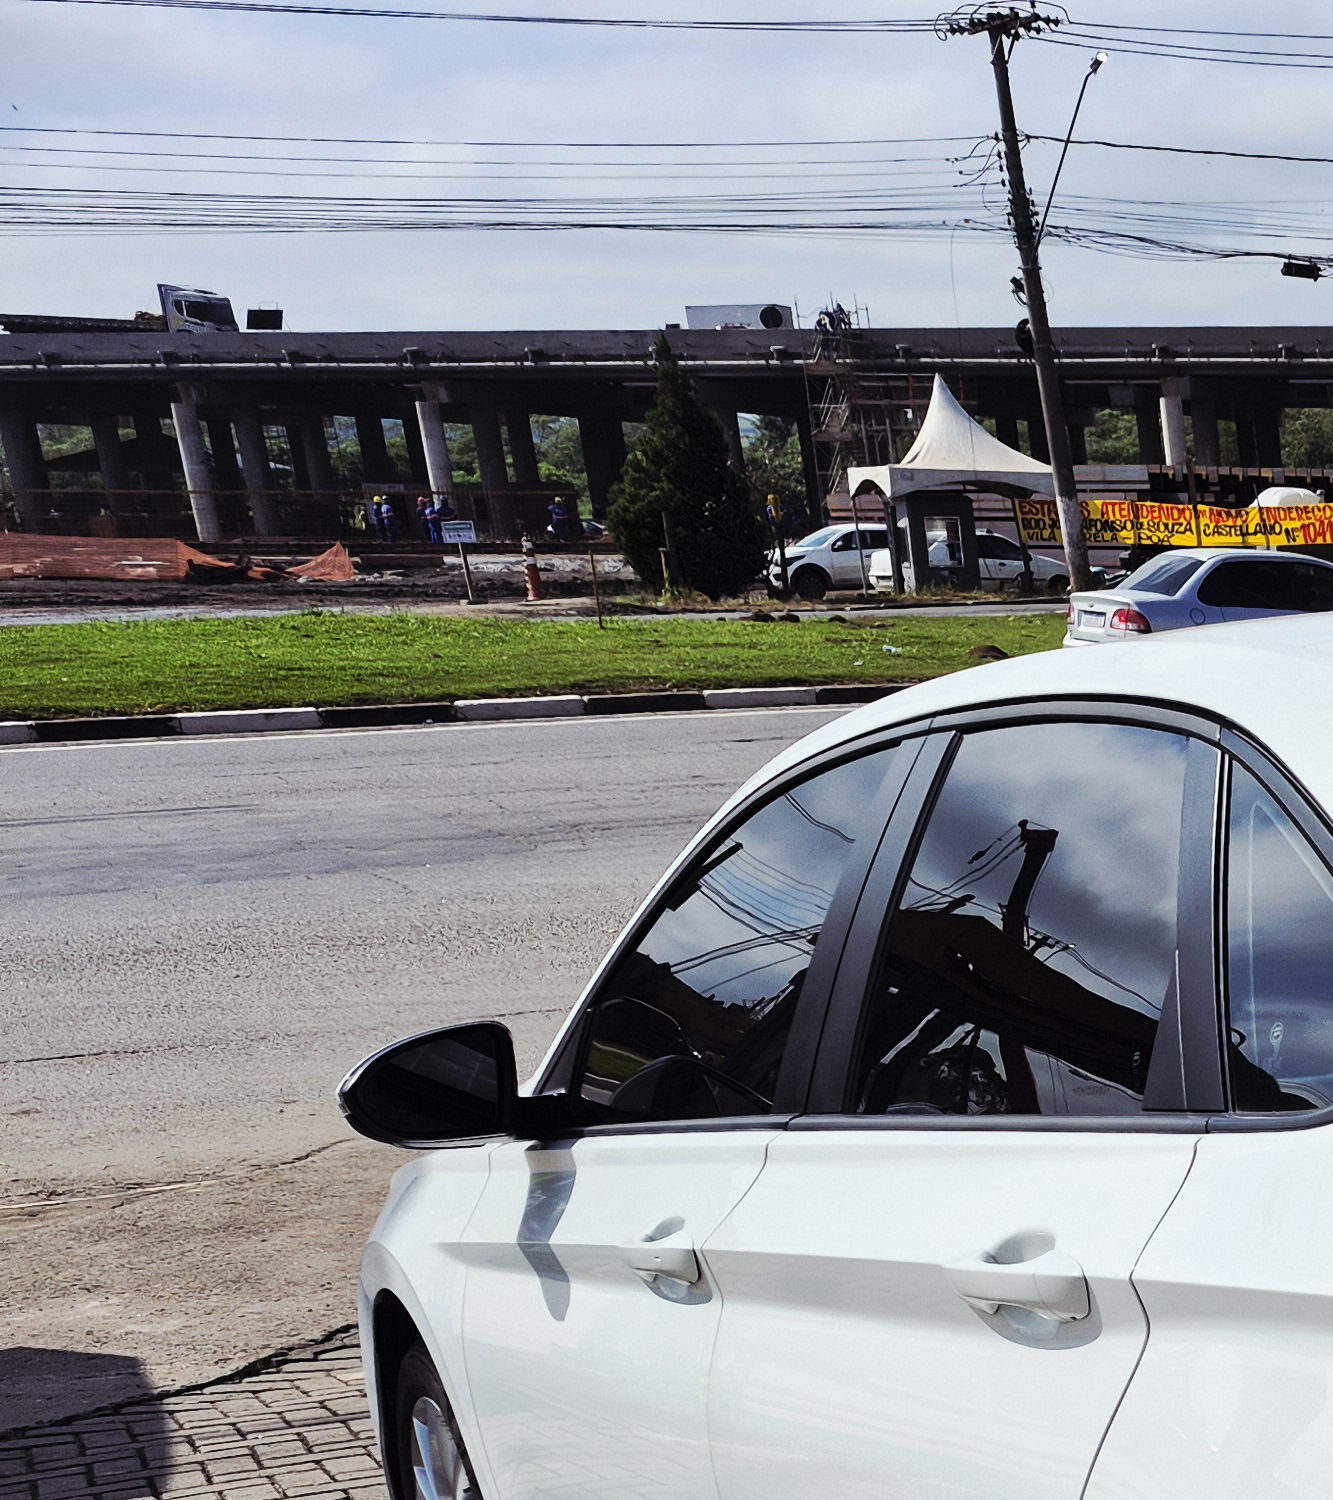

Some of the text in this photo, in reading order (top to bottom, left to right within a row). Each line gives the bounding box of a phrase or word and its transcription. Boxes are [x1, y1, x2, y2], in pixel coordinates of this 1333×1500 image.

[1018, 500, 1092, 519] ESTAS
[1101, 501, 1193, 522] ATENDENDO
[1027, 531, 1058, 542] VILA
[1085, 532, 1119, 543] RELA
[1147, 520, 1195, 535] SOUZA
[1202, 521, 1283, 538] CASTELLANO
